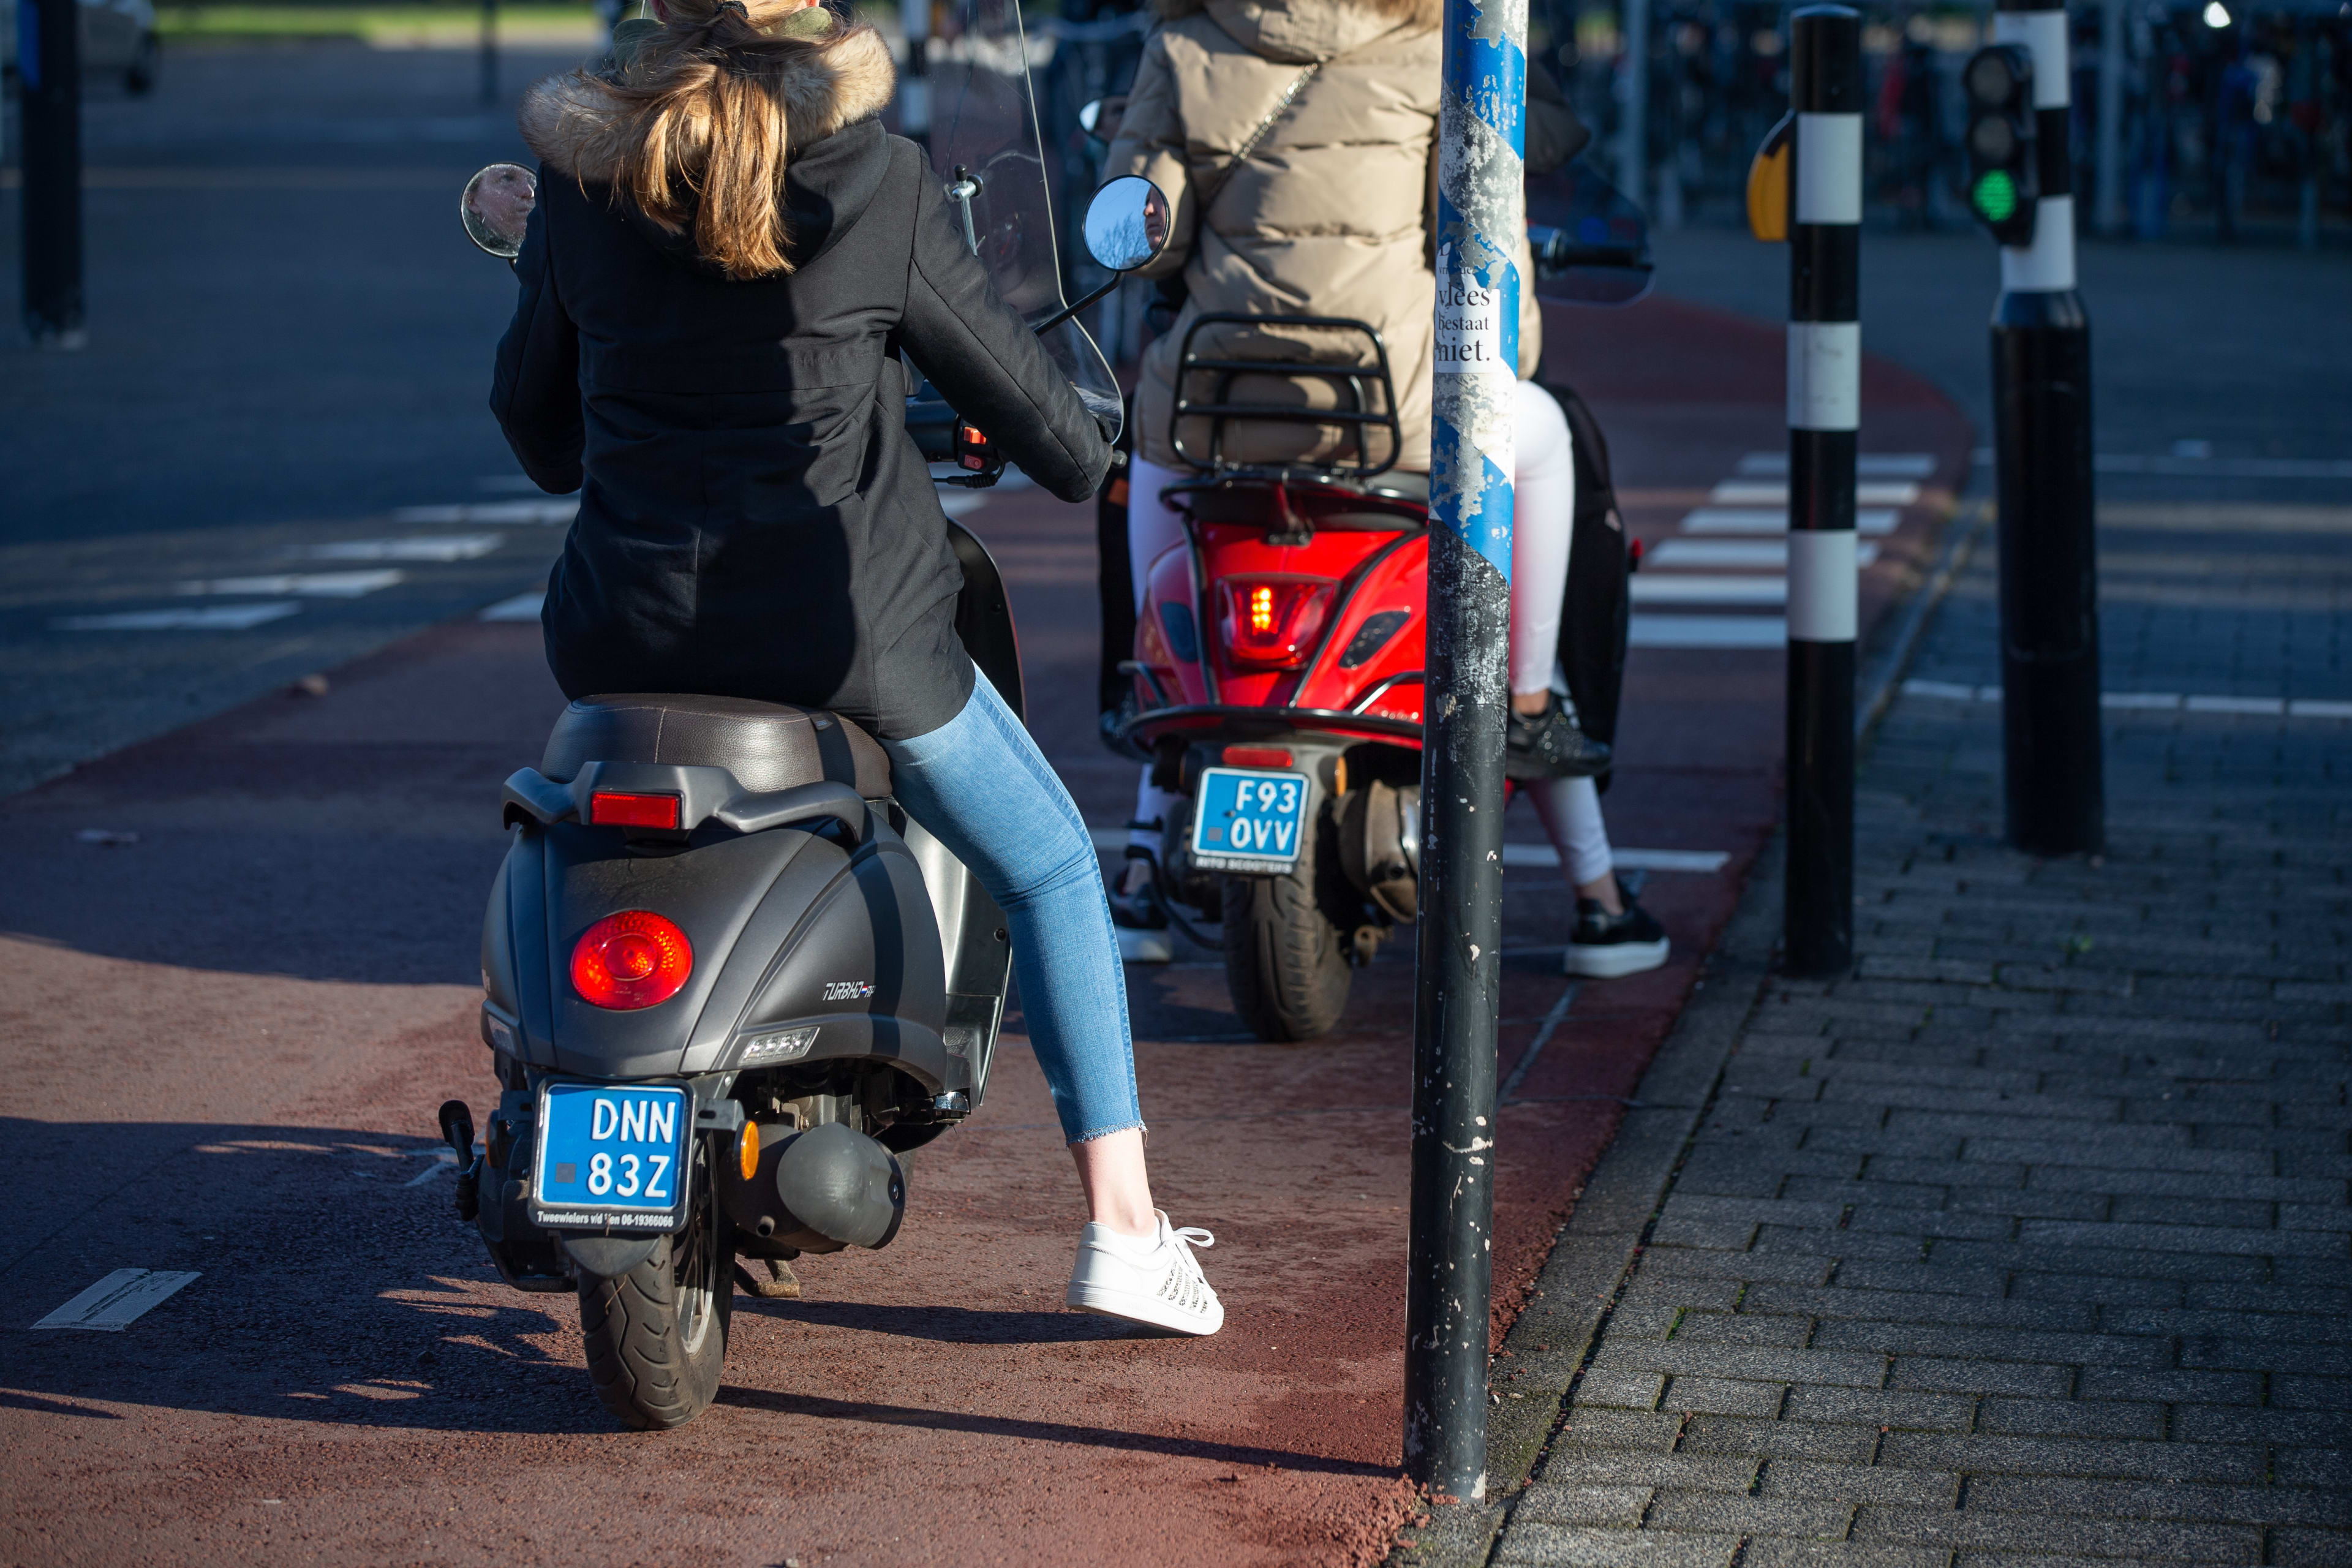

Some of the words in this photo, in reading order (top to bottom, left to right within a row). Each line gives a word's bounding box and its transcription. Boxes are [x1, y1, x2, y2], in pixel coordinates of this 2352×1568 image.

[1438, 314, 1490, 331] bestaat
[1438, 336, 1490, 361] niet.
[1235, 779, 1297, 814] F93
[591, 1098, 676, 1144] DNN
[587, 1152, 671, 1197] 83Z
[537, 1210, 589, 1224] Tweewielers
[590, 1212, 603, 1224] v/d
